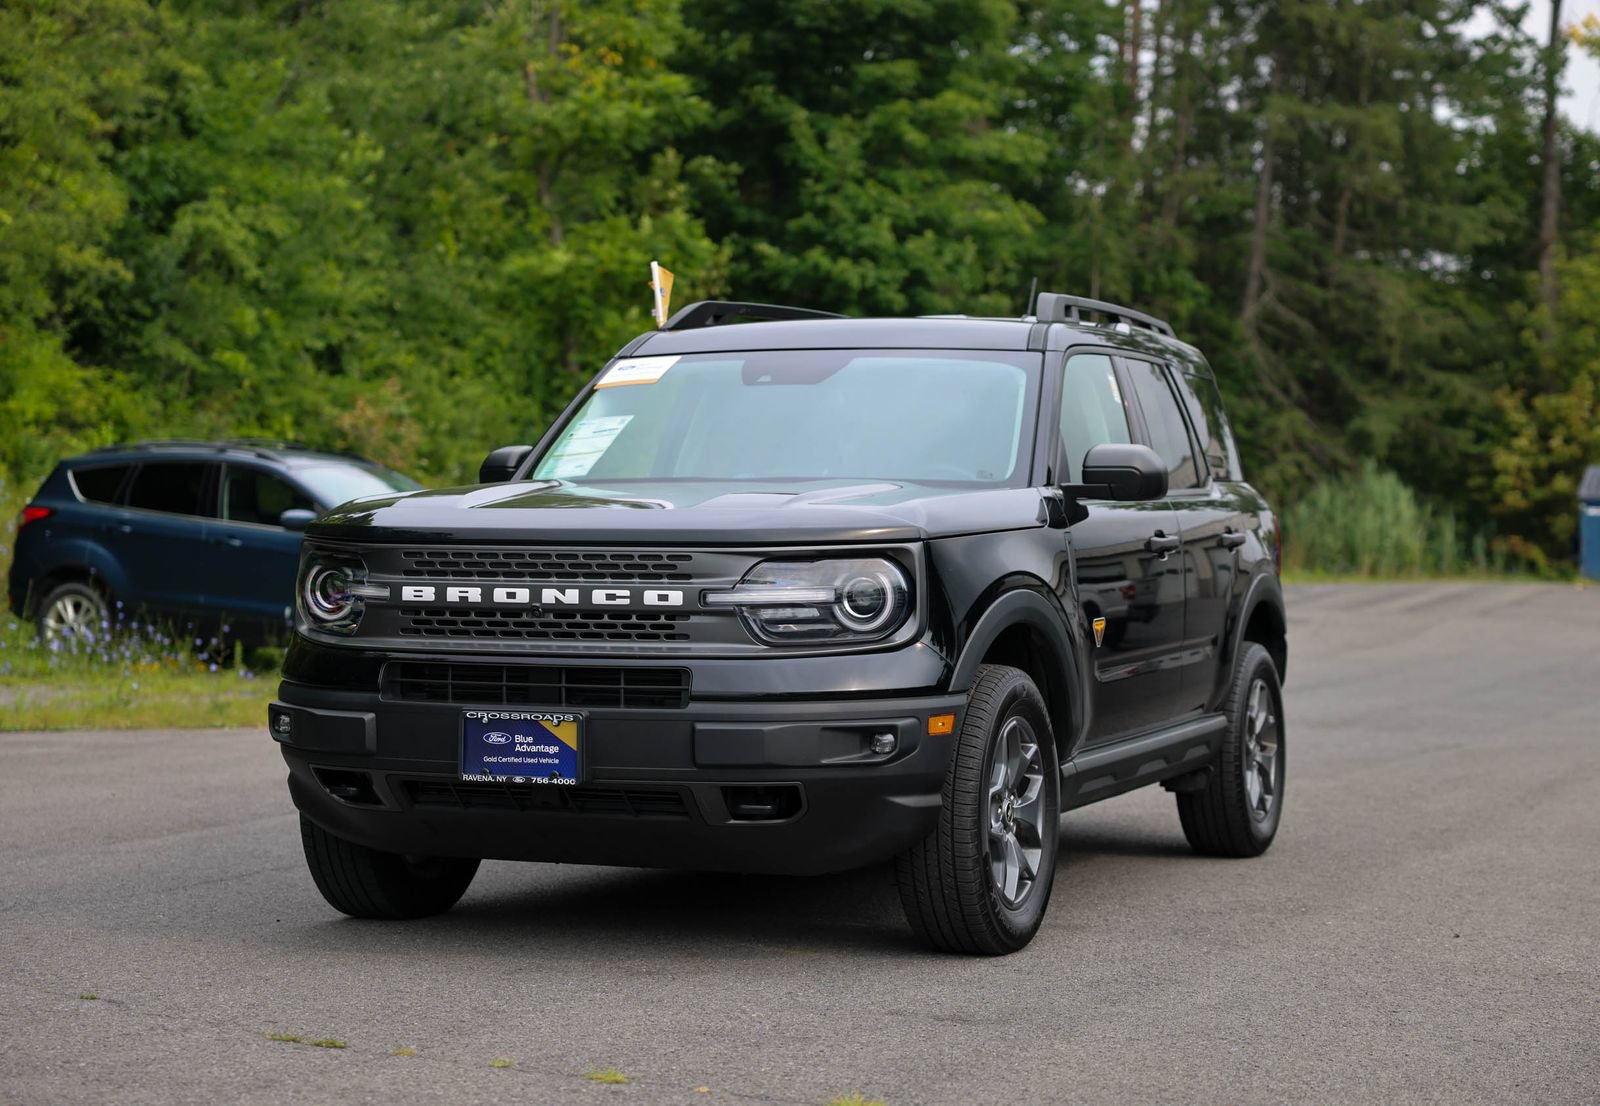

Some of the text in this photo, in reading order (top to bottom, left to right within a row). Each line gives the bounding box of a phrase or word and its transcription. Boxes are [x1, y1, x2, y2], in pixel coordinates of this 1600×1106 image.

[402, 585, 683, 605] BRONCO
[466, 711, 574, 721] CROSSROADS
[514, 734, 534, 743] Blue
[515, 743, 559, 754] Advantage
[496, 775, 507, 783] NY
